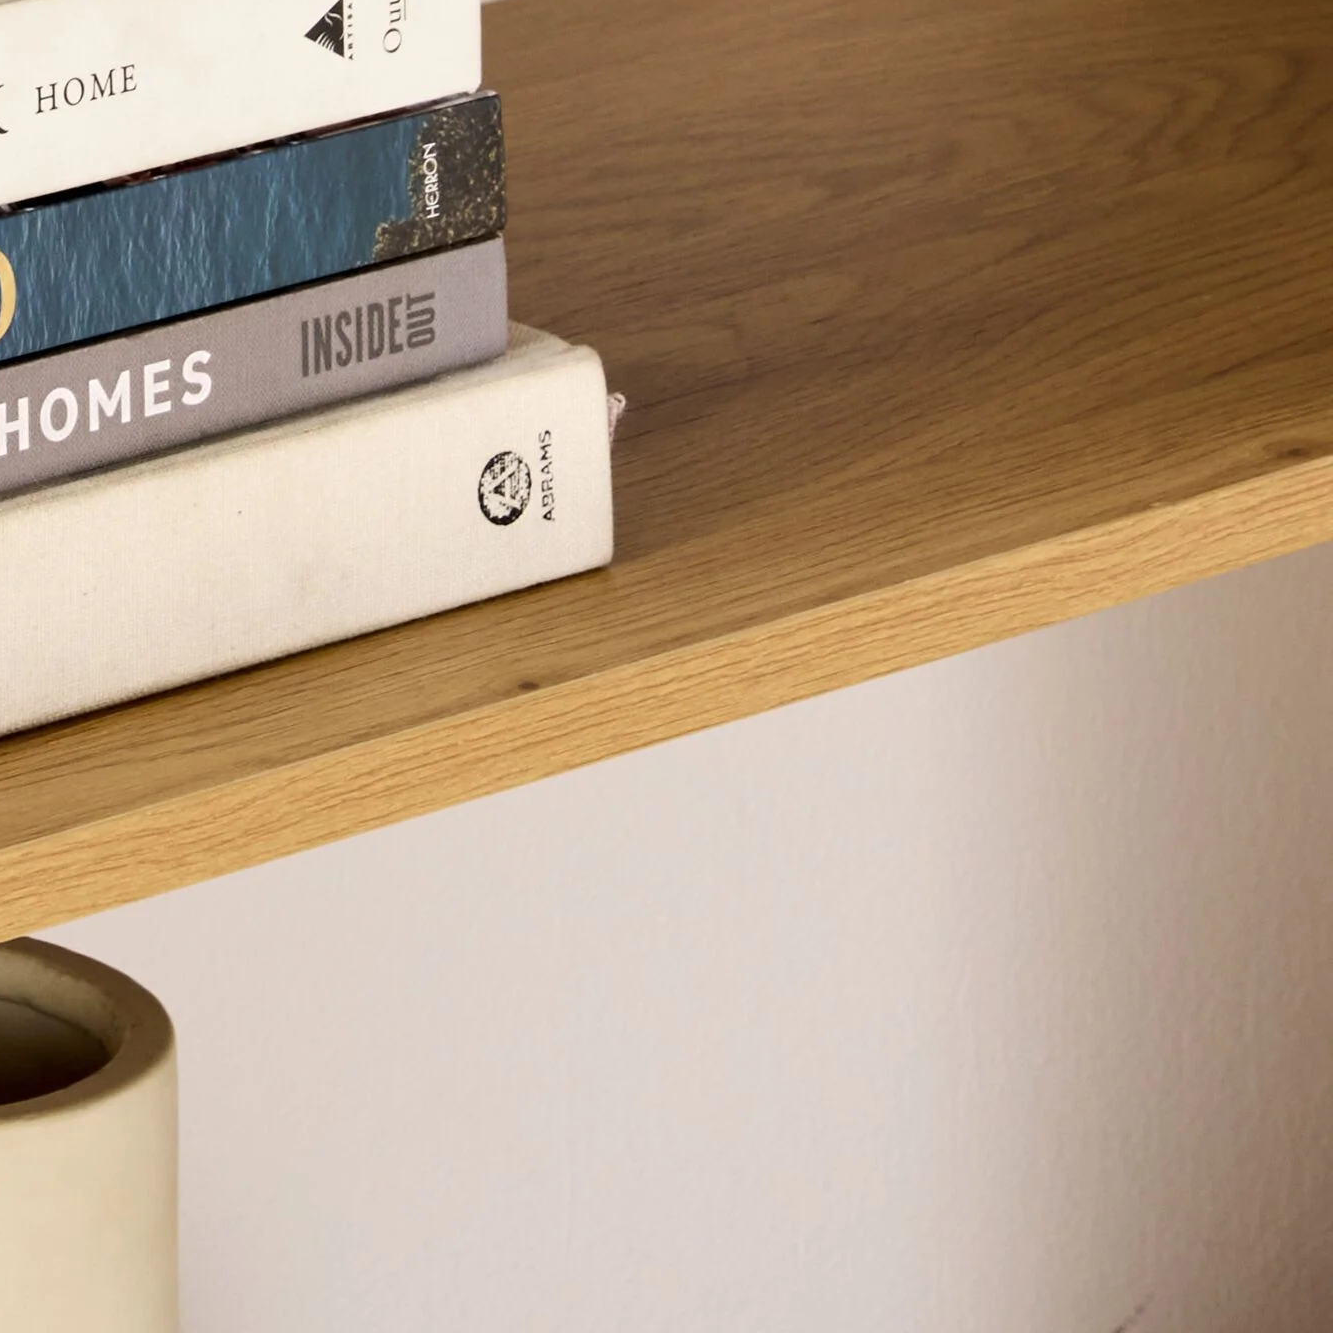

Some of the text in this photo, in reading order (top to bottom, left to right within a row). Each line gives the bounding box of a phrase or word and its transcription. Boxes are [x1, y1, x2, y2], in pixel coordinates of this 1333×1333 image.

[34, 63, 138, 116] HOME
[422, 142, 440, 219] HERRON
[301, 296, 404, 378] INSIDE
[406, 291, 436, 349] OUT
[538, 429, 556, 522] ABRAMS
